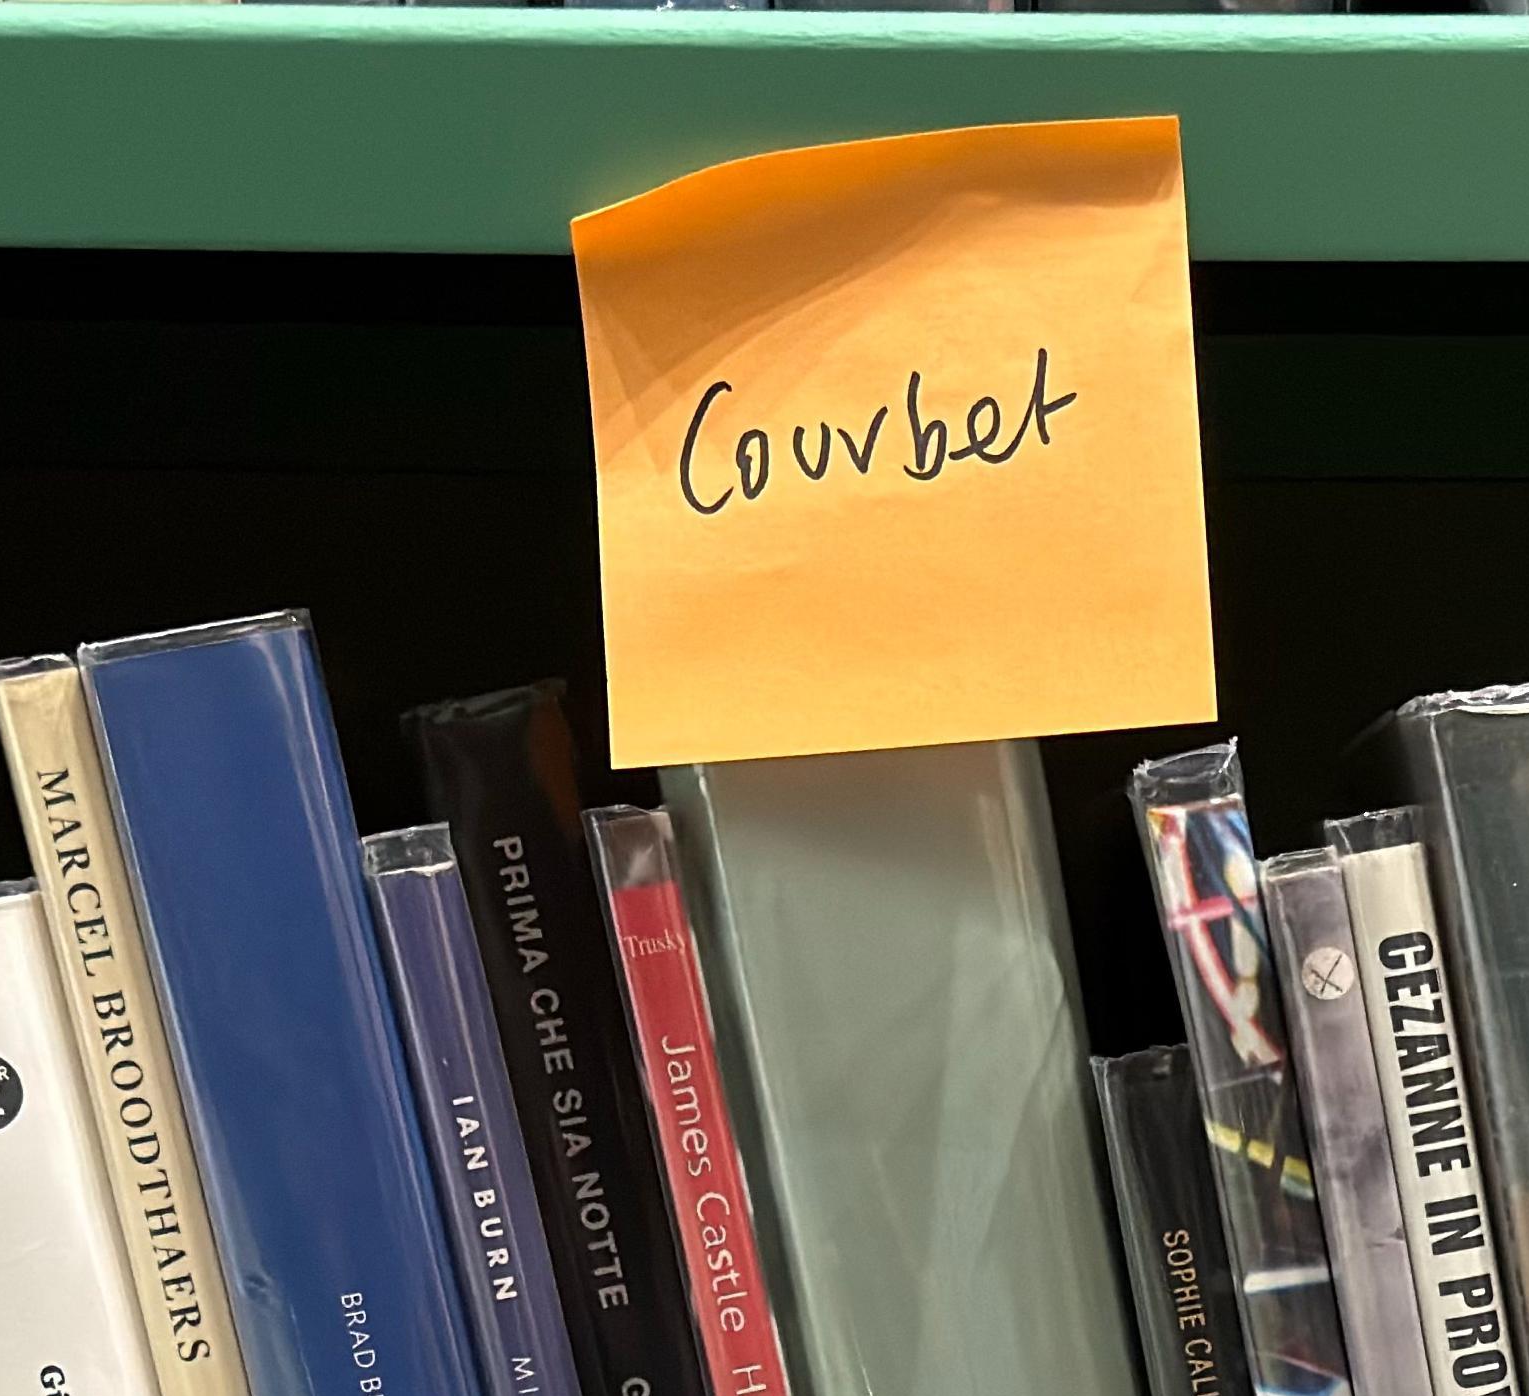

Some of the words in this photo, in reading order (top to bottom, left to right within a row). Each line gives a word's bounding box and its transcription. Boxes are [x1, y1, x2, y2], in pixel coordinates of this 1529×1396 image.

[679, 348, 1077, 515] Courbet
[493, 836, 548, 974] PRIMA
[623, 931, 688, 960] Trusky
[36, 768, 113, 978] MARCEL
[93, 993, 212, 1364] BROODTHAERS
[531, 987, 574, 1076] CHE
[1377, 929, 1472, 1178] CEZANNE
[552, 1089, 595, 1159] SIA
[662, 1034, 713, 1178] James
[696, 1192, 746, 1334] Castle
[452, 1095, 489, 1172] IAN
[473, 1190, 518, 1302] BURN
[571, 1172, 630, 1311] NOTTE
[1424, 1194, 1485, 1256] IN
[342, 1292, 375, 1369] BRAD
[1163, 1229, 1205, 1340] SOPHIE
